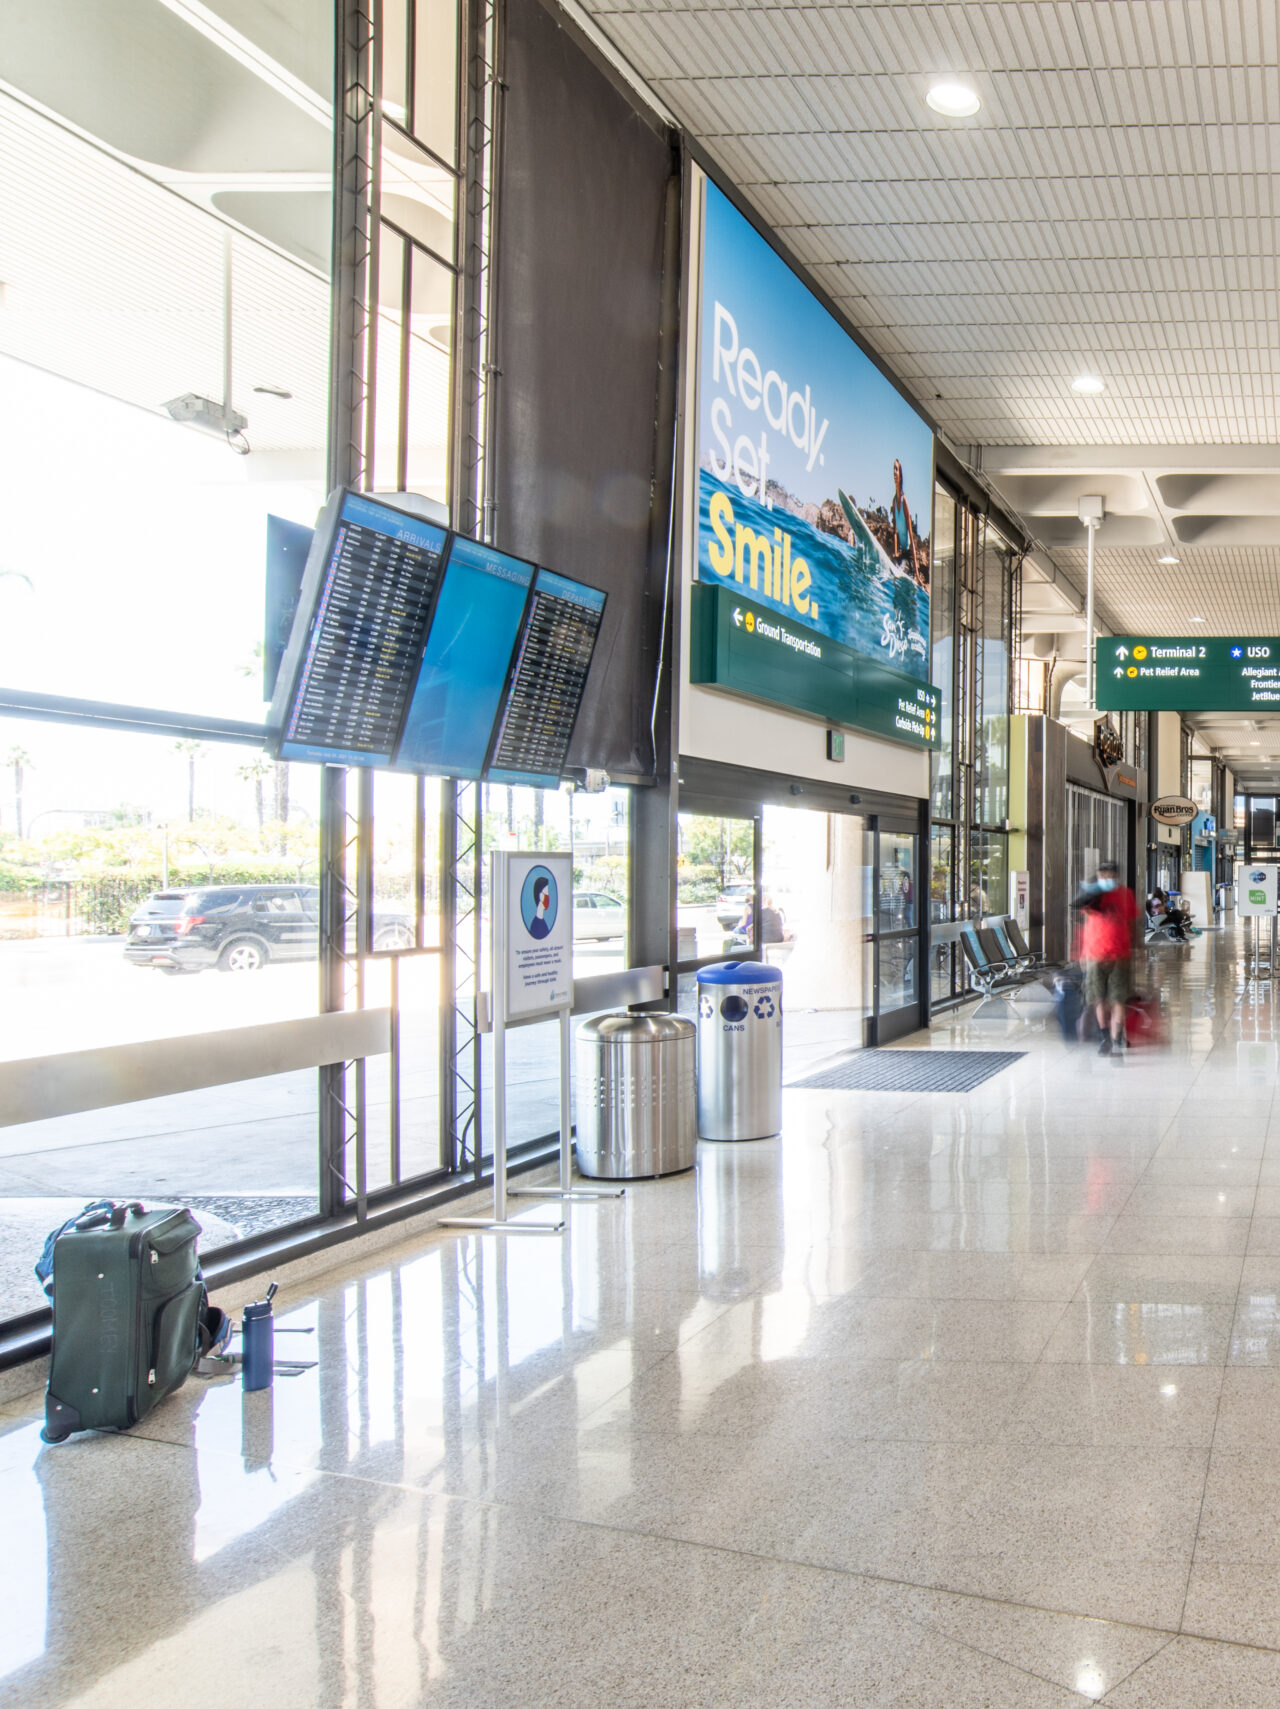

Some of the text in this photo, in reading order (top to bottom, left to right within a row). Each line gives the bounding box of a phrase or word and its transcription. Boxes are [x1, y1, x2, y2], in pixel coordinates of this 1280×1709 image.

[713, 301, 829, 472] Ready.
[709, 397, 773, 511] Set.
[396, 529, 442, 555] ARRIVALS
[708, 491, 818, 620] Smile.
[486, 562, 531, 586] MESSAGING
[756, 617, 821, 658] Ground Transportation
[881, 612, 897, 647] San
[1150, 646, 1206, 658] Terminal 2
[1247, 646, 1270, 658] USO
[1140, 666, 1200, 677] Pet Relief Area
[1241, 667, 1277, 679] Allegiant
[917, 688, 925, 702] USO
[1252, 691, 1280, 701] JetBlue
[906, 700, 916, 716] Relief
[916, 703, 925, 718] Area
[895, 715, 912, 733] Curbside
[1154, 806, 1176, 816] Ryan
[723, 1024, 745, 1032] CANS
